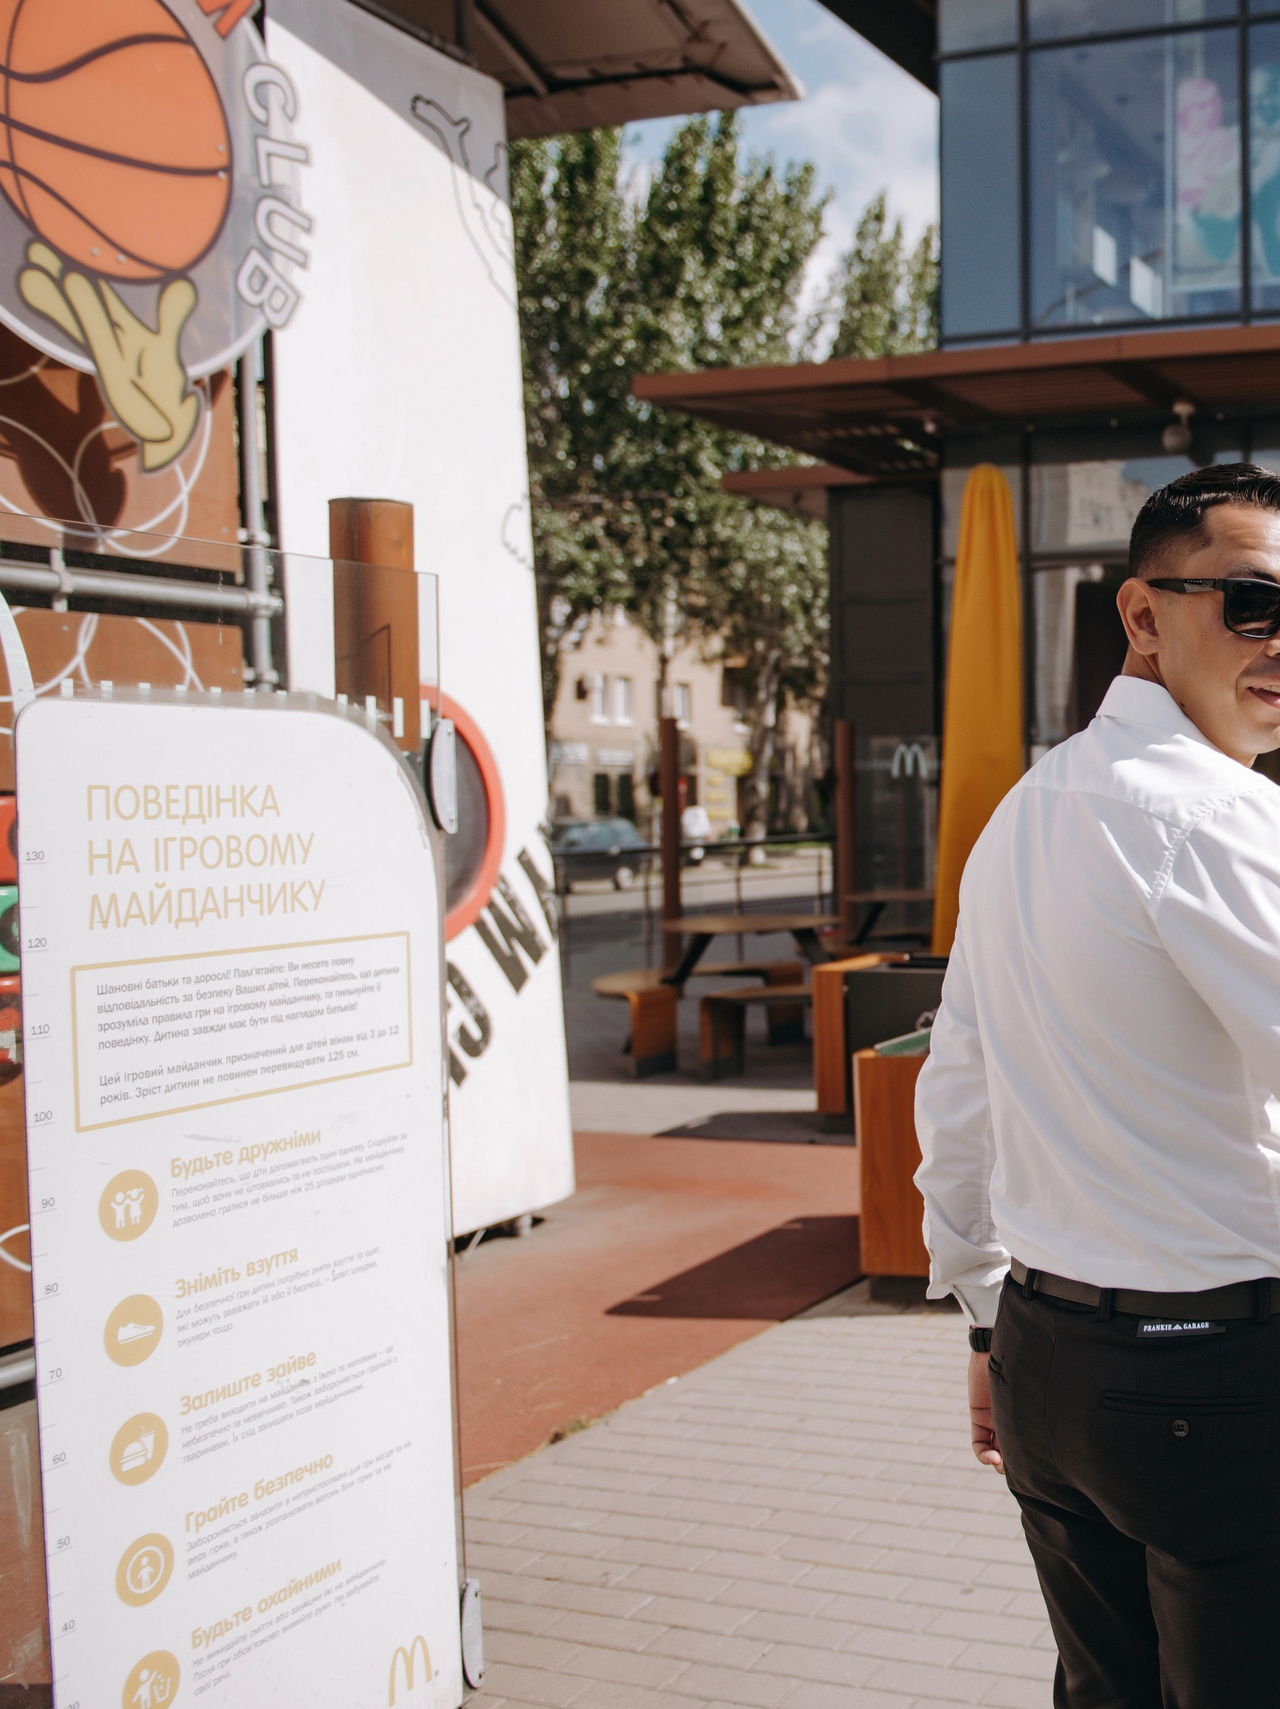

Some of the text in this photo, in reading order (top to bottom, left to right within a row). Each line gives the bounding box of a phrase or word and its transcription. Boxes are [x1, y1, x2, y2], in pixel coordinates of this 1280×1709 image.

[243, 62, 313, 330] CLUB
[86, 784, 281, 825] ПОВЕДІНКА
[25, 850, 45, 861] 130
[87, 832, 315, 877] НА ІГРОВОМУ
[88, 879, 326, 931] МАЙДАНЧИКУ
[28, 937, 47, 948] 120
[96, 957, 355, 996] Шановні батьки та дорослі! Пам'ятайте: Ви несете повну
[96, 994, 181, 1015] відповідальність
[182, 993, 194, 1003] за
[195, 988, 234, 1001] безпеку
[235, 984, 266, 996] Ваших
[359, 970, 372, 979] що
[30, 1024, 50, 1035] 110
[97, 1015, 150, 1034] зрозуміла
[151, 1010, 193, 1026] правила
[194, 1008, 211, 1020] гри
[213, 1006, 225, 1016] на
[227, 1000, 267, 1015] ігровому
[324, 990, 334, 999] та
[153, 1028, 190, 1044] Дитина
[191, 1022, 227, 1036] завжди
[228, 1019, 248, 1030] має
[248, 1015, 269, 1029] бути
[270, 1013, 284, 1024] під
[99, 1024, 399, 1088] Цей ігровий майданчик призначений для дітей віком від 3 до 12
[134, 1084, 162, 1100] Зріст
[164, 1078, 200, 1094] дитини
[202, 1075, 215, 1086] не
[217, 1068, 258, 1083] повинен
[260, 1055, 326, 1075] перевищувати
[327, 1049, 345, 1063] 125
[33, 1110, 53, 1123] 100
[170, 1129, 321, 1181] Будьте дружніми
[41, 1197, 55, 1209] 90
[45, 1283, 59, 1295] 80
[174, 1247, 299, 1300] Зніміть взуття
[1143, 1322, 1210, 1332] FRANKIE GARAGE
[49, 1368, 63, 1381] 70
[179, 1351, 317, 1417] Залиште зайве
[52, 1452, 67, 1465] 60
[184, 1453, 334, 1534] Грайте безпечно
[57, 1536, 71, 1549] 50
[190, 1558, 342, 1650] Будьте охайними
[62, 1619, 76, 1631] 40
